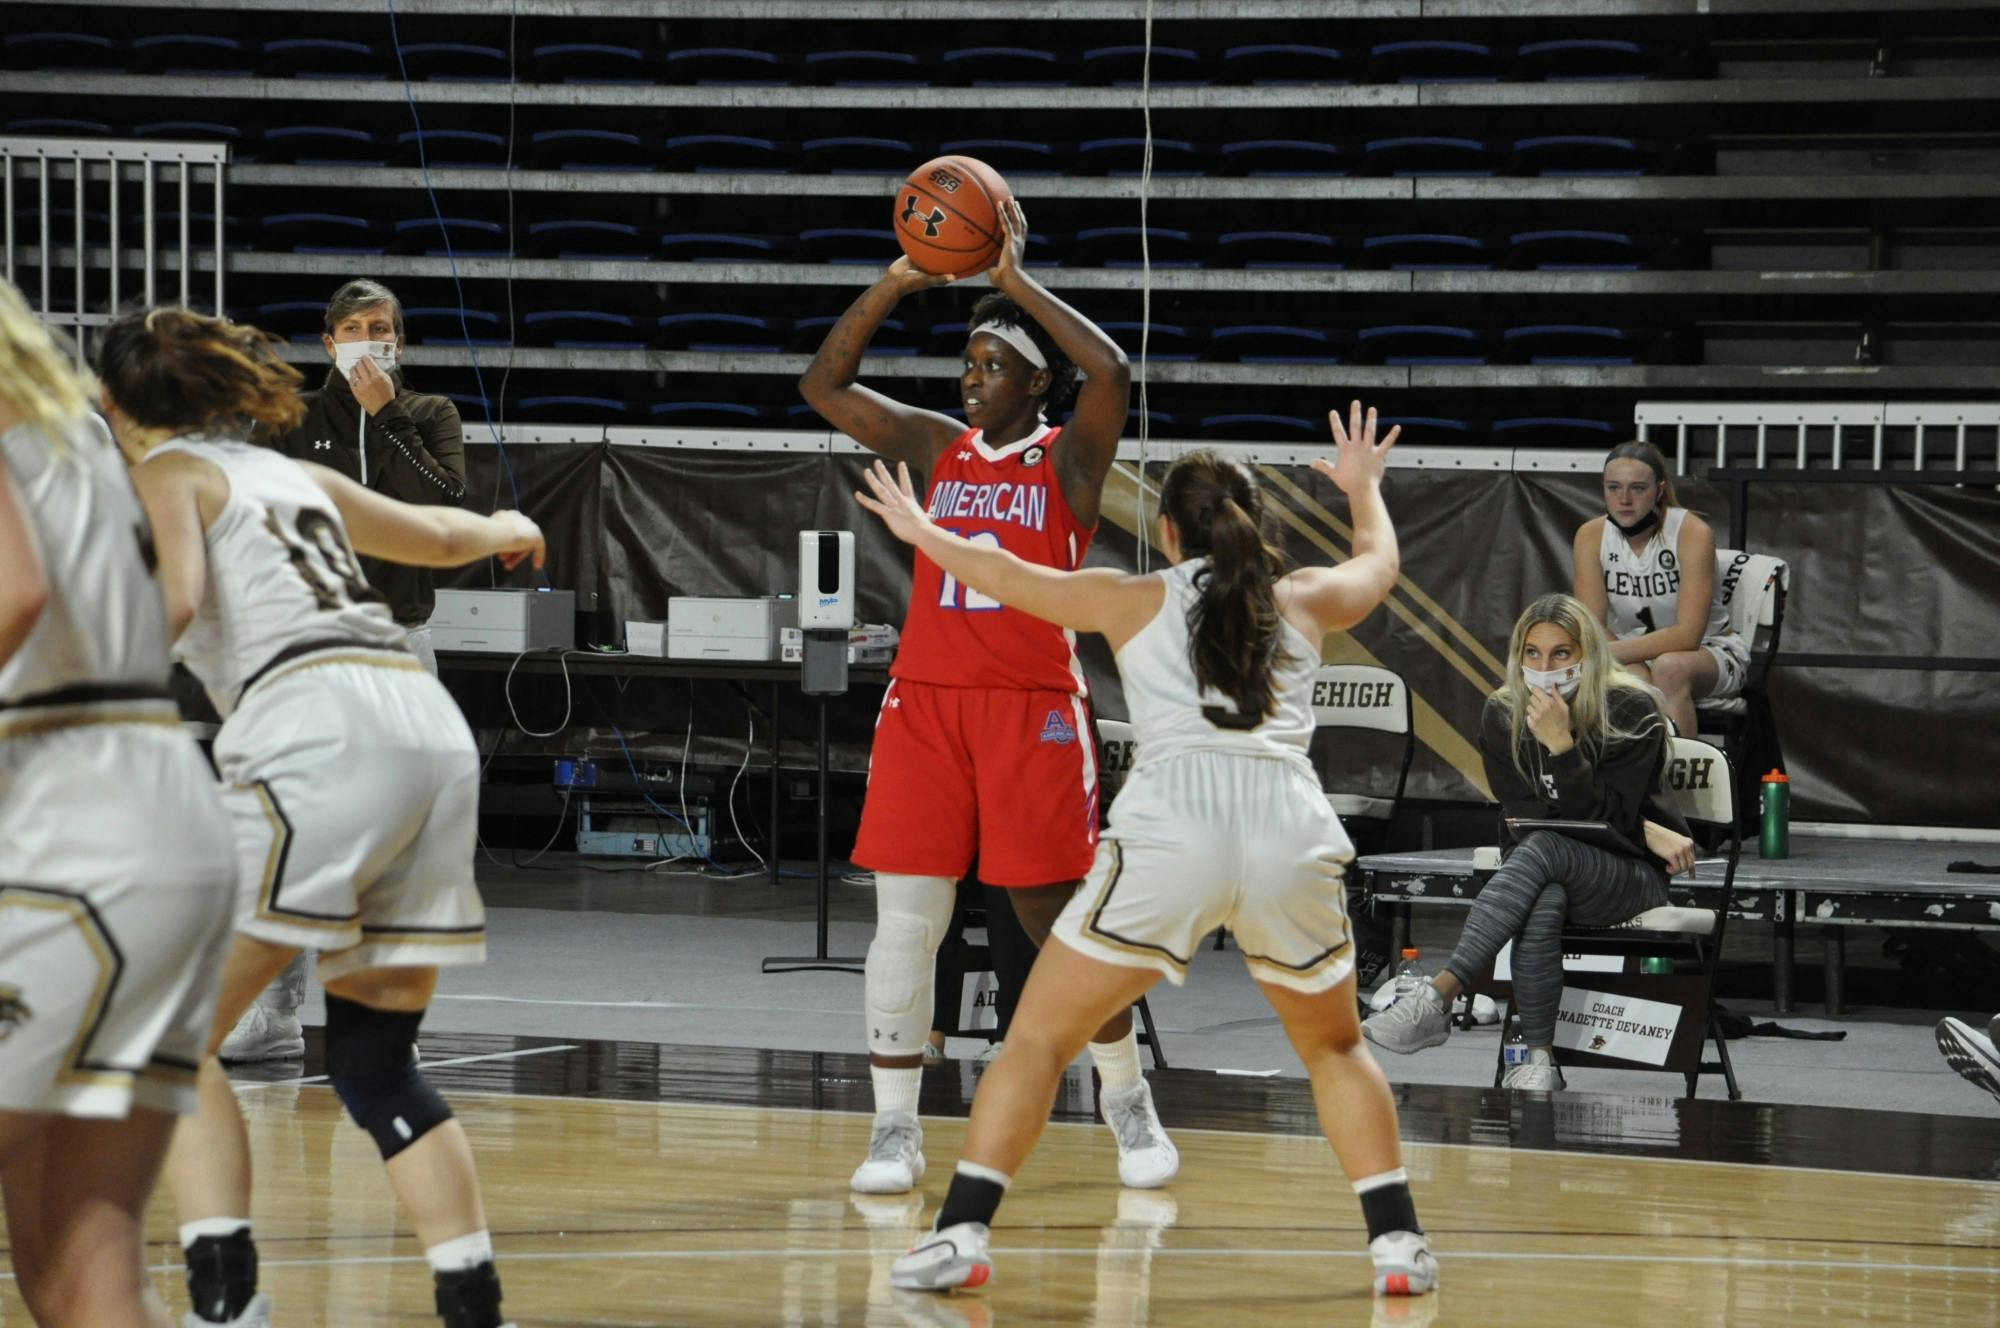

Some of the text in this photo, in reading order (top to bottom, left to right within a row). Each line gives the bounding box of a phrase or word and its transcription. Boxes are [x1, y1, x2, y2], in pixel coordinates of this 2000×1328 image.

[928, 480, 1047, 532] AMERICAN
[1604, 570, 1680, 598] LEHIGH
[1721, 553, 1750, 606] GATO
[1311, 680, 1395, 708] EHIGH
[1668, 758, 1715, 791] GH
[973, 989, 999, 1007] AD
[1592, 1002, 1626, 1017] COACH
[1556, 1009, 1673, 1040] NADETTE DEVANEY
